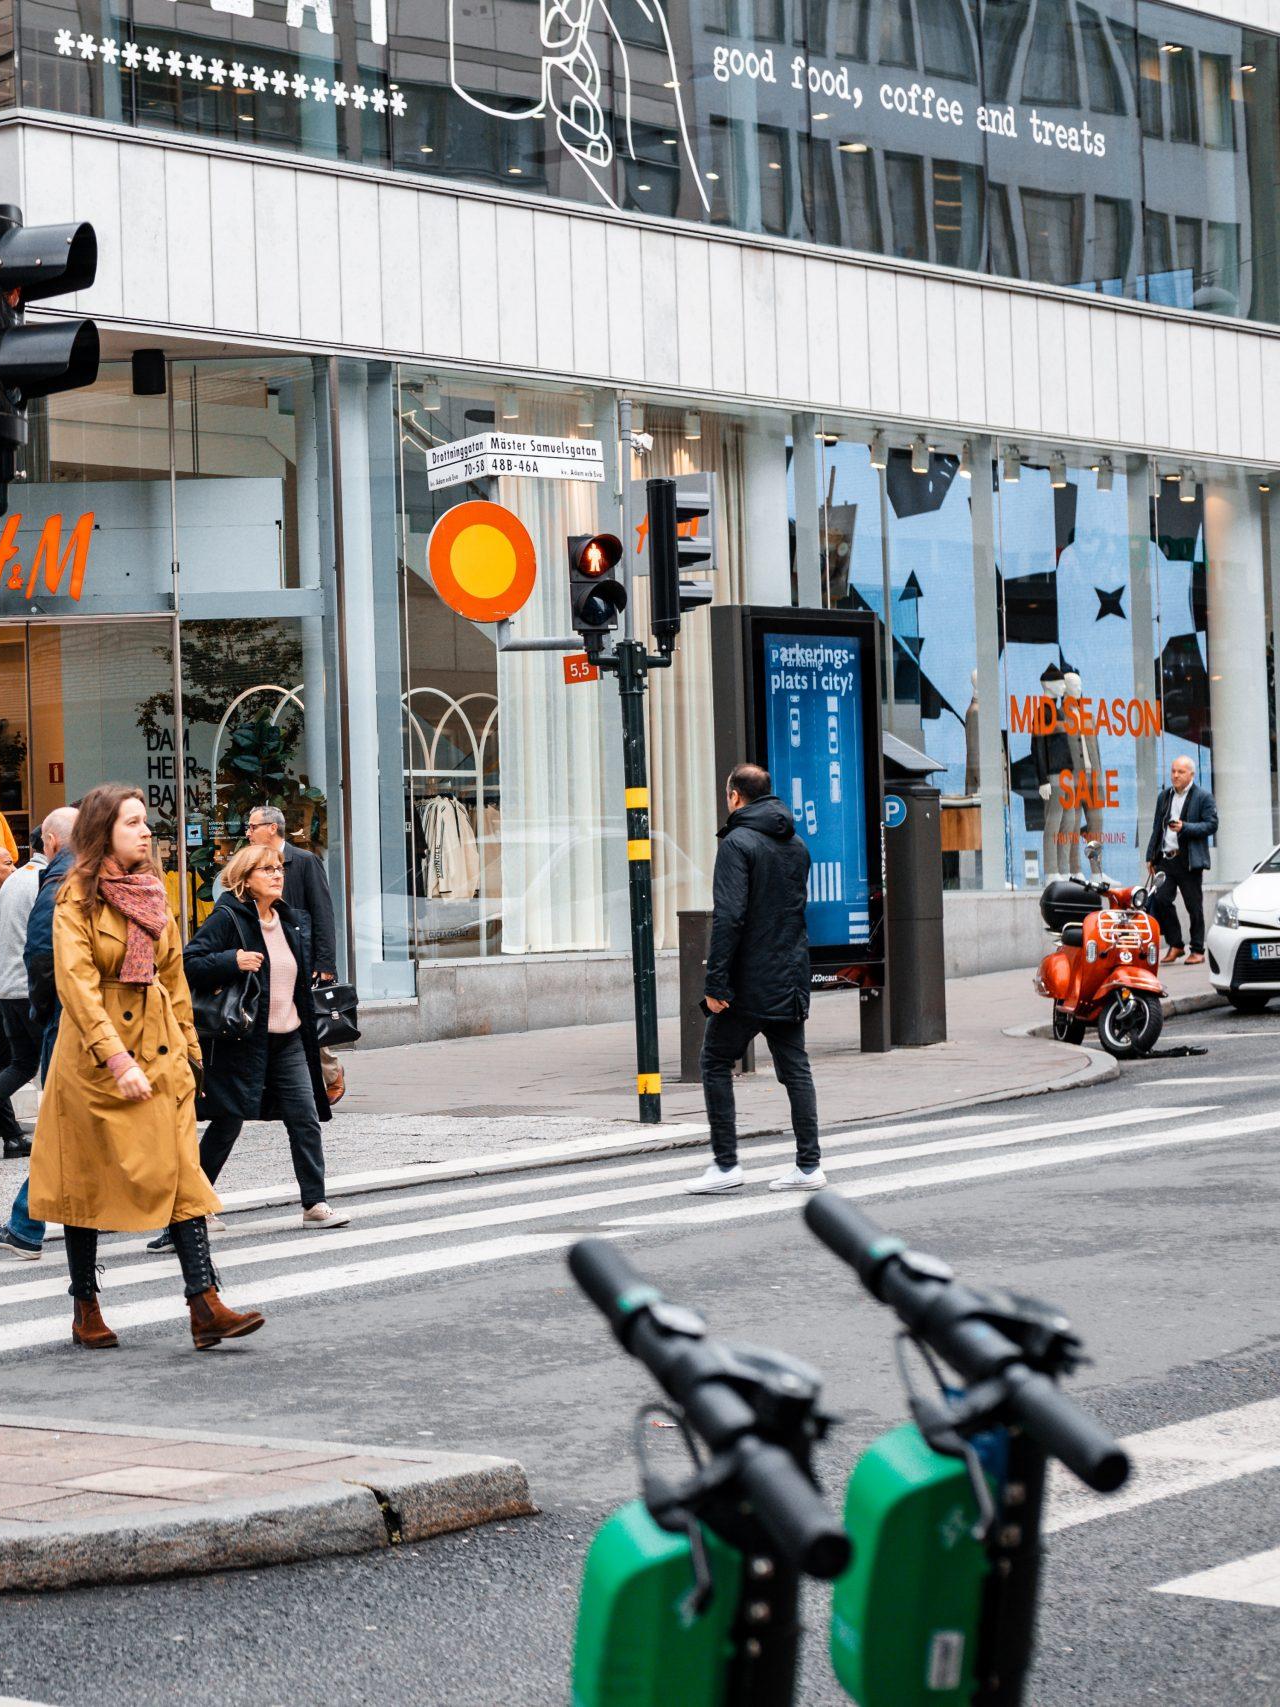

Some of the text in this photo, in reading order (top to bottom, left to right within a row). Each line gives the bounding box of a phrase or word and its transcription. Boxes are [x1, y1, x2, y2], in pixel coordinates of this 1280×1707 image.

[713, 46, 1106, 157] good food, coffee and treats
[432, 441, 484, 464] Drottninggatan
[491, 437, 597, 458] Mäster Samuelsgatan
[464, 459, 485, 477] 70-58
[492, 459, 539, 473] 48B-46A
[570, 662, 590, 678] 5,5
[771, 670, 854, 697] plats i city?
[1010, 695, 1161, 737] MID SEASON
[1059, 769, 1120, 810] SALE
[885, 801, 900, 822] P
[811, 973, 838, 983] JCDecaux
